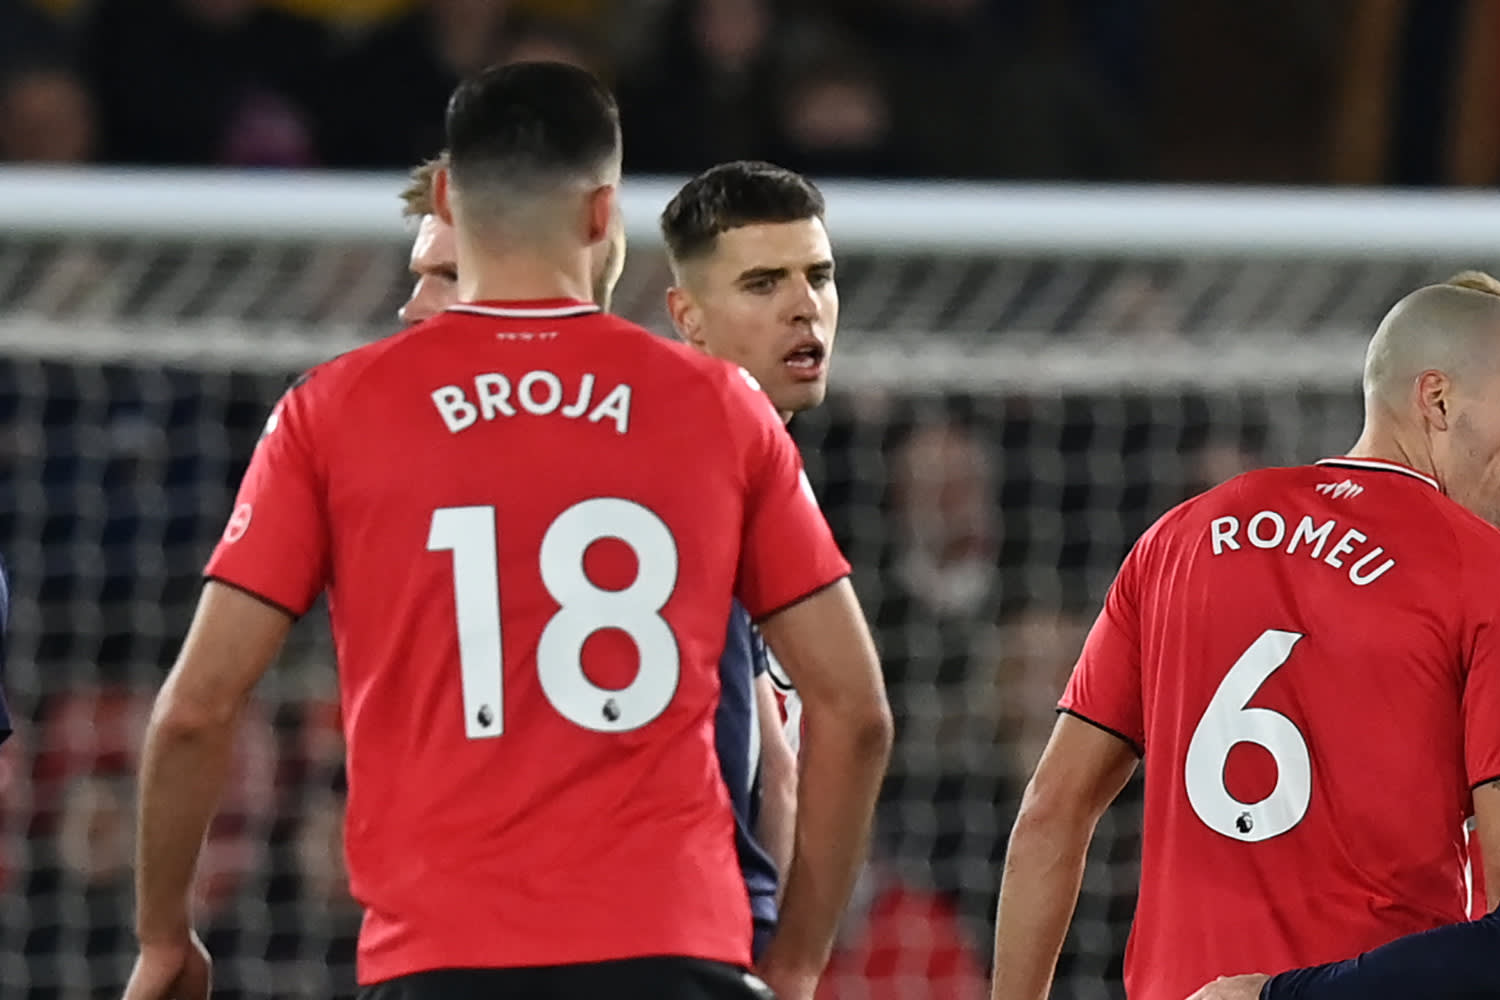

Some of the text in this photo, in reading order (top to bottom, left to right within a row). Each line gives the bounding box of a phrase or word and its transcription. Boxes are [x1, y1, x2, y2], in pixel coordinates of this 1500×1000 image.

[431, 369, 632, 434] BROJA
[426, 496, 681, 739] 18
[1210, 510, 1396, 586] ROMEU
[1184, 628, 1313, 843] 6
